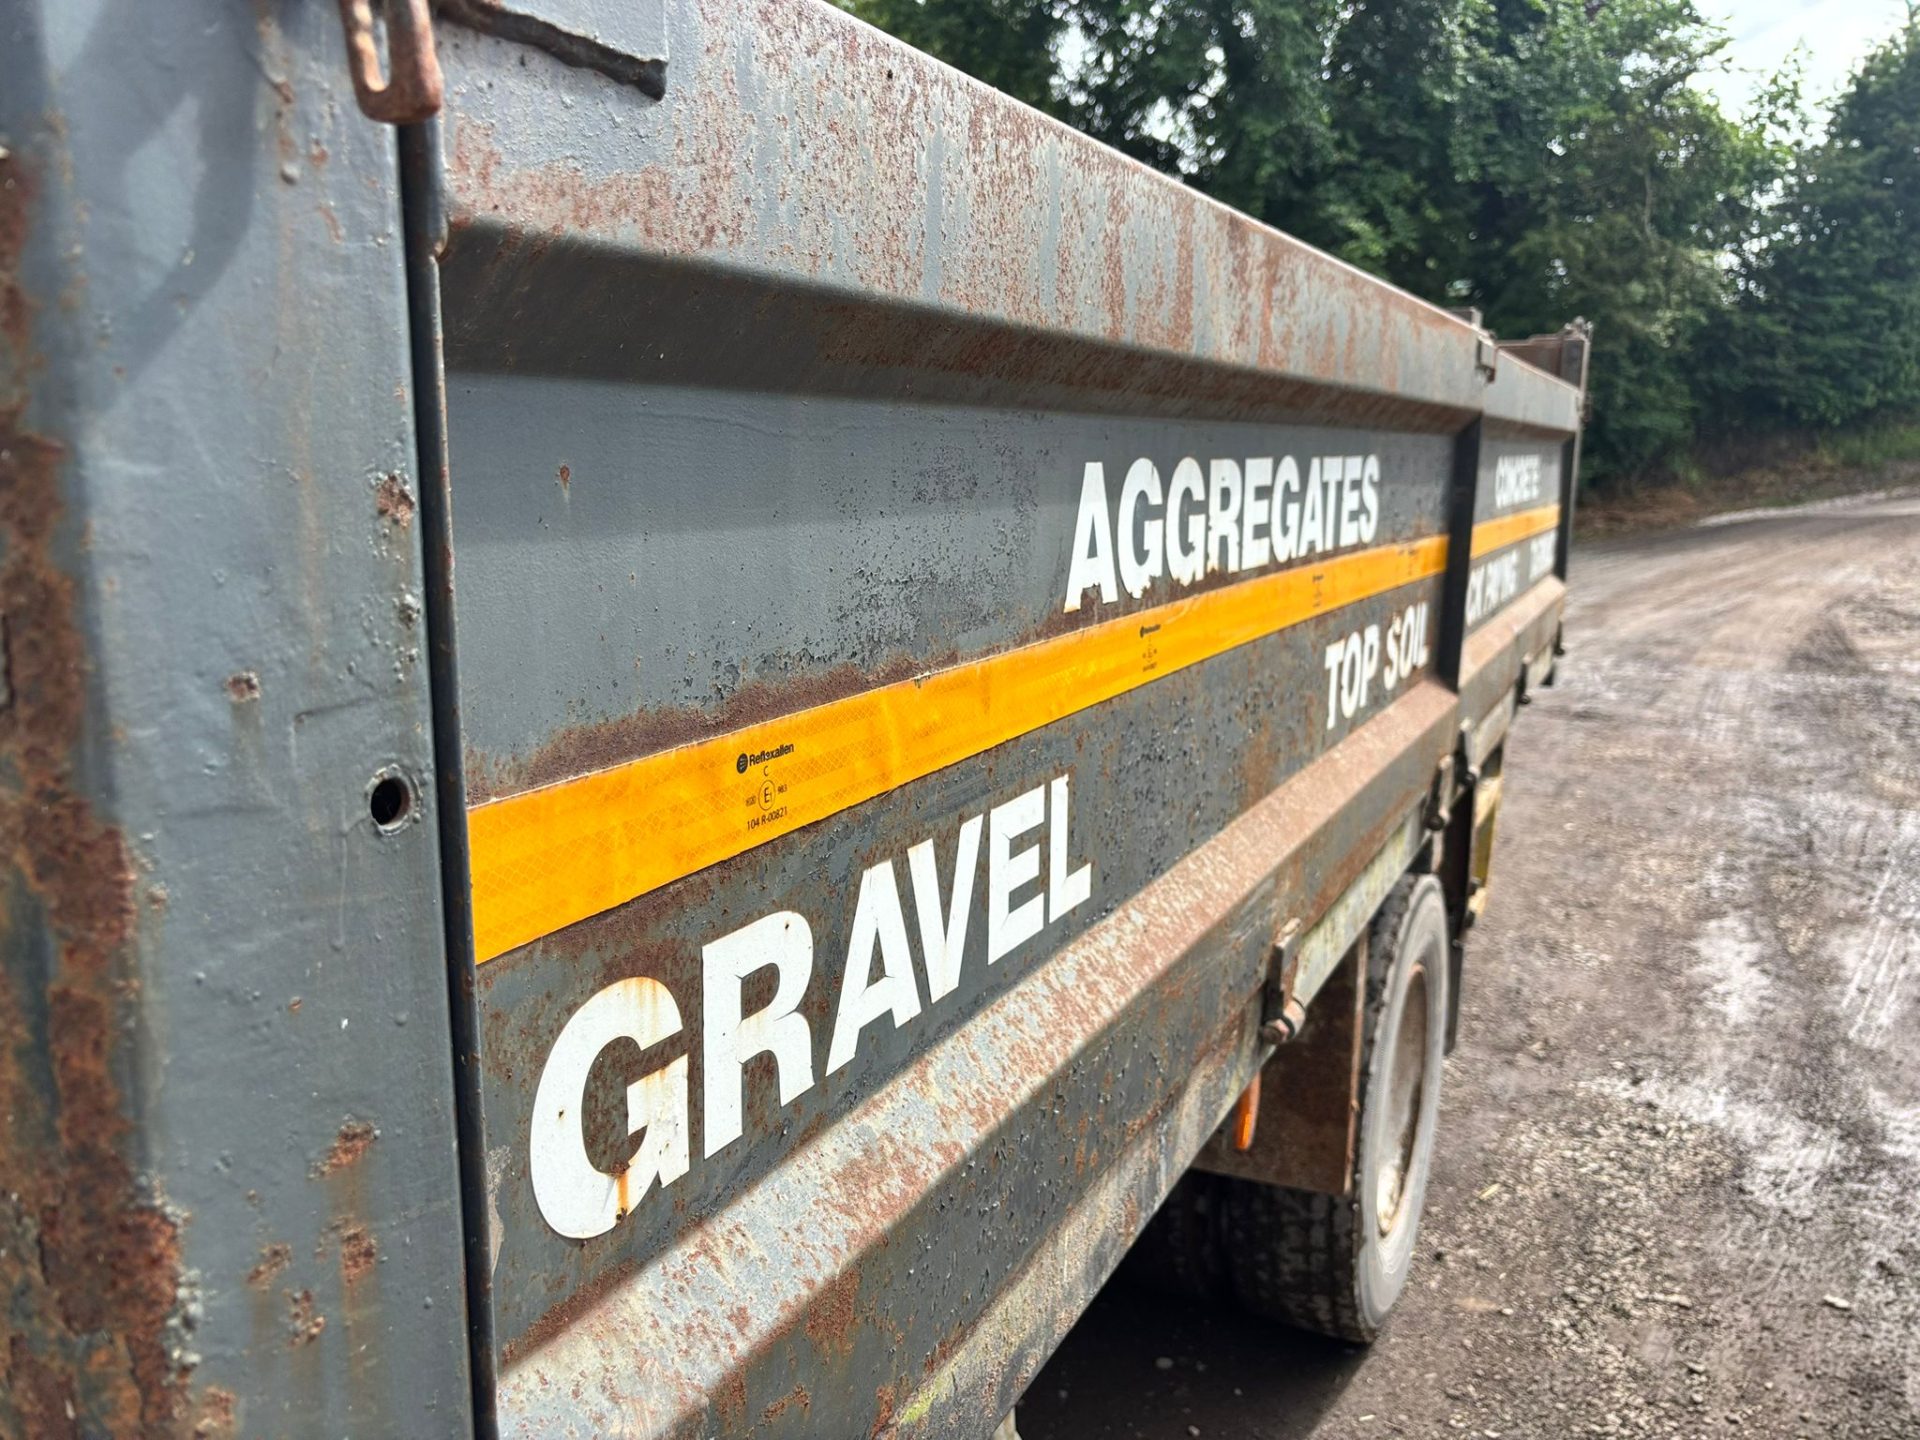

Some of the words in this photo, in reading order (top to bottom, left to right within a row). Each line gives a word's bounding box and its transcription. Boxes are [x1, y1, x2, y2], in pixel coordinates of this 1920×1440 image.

[1063, 455, 1380, 613] AGGREGATES
[1325, 624, 1379, 730] TOP
[1384, 602, 1428, 690] SOIL
[747, 817, 760, 831] 104
[530, 774, 1091, 1238] GRAVEL
